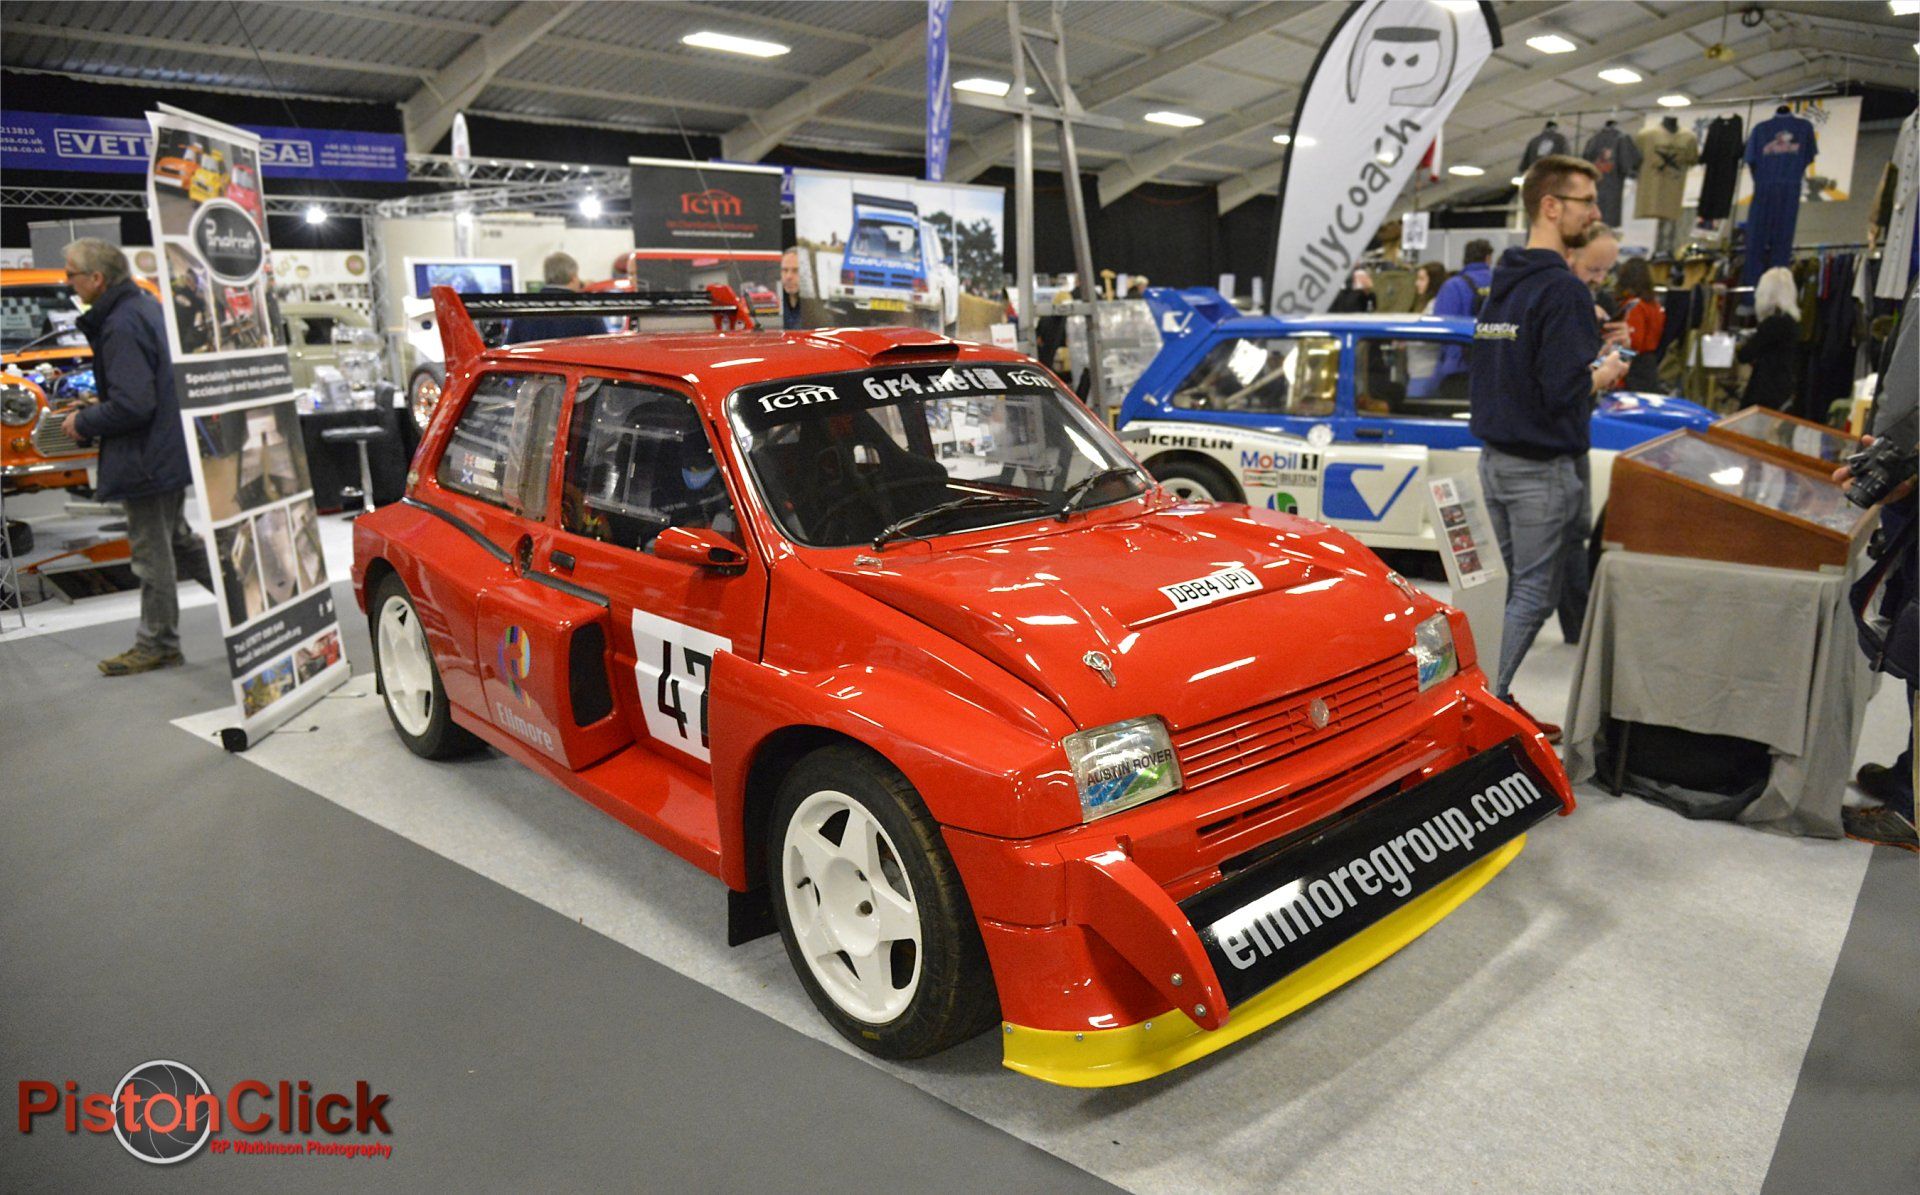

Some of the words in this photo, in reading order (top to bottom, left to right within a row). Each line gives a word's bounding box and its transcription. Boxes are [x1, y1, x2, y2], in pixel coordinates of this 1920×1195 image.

[1277, 118, 1421, 316] Rallycoach
[863, 368, 983, 402] 6r4.net
[1240, 450, 1297, 470] Mobil
[657, 639, 713, 750] 47
[496, 703, 555, 751] Ellmore
[1087, 761, 1131, 786] AUSTIN
[1133, 749, 1172, 769] ROVER
[1218, 771, 1542, 971] ellmoregroup.com
